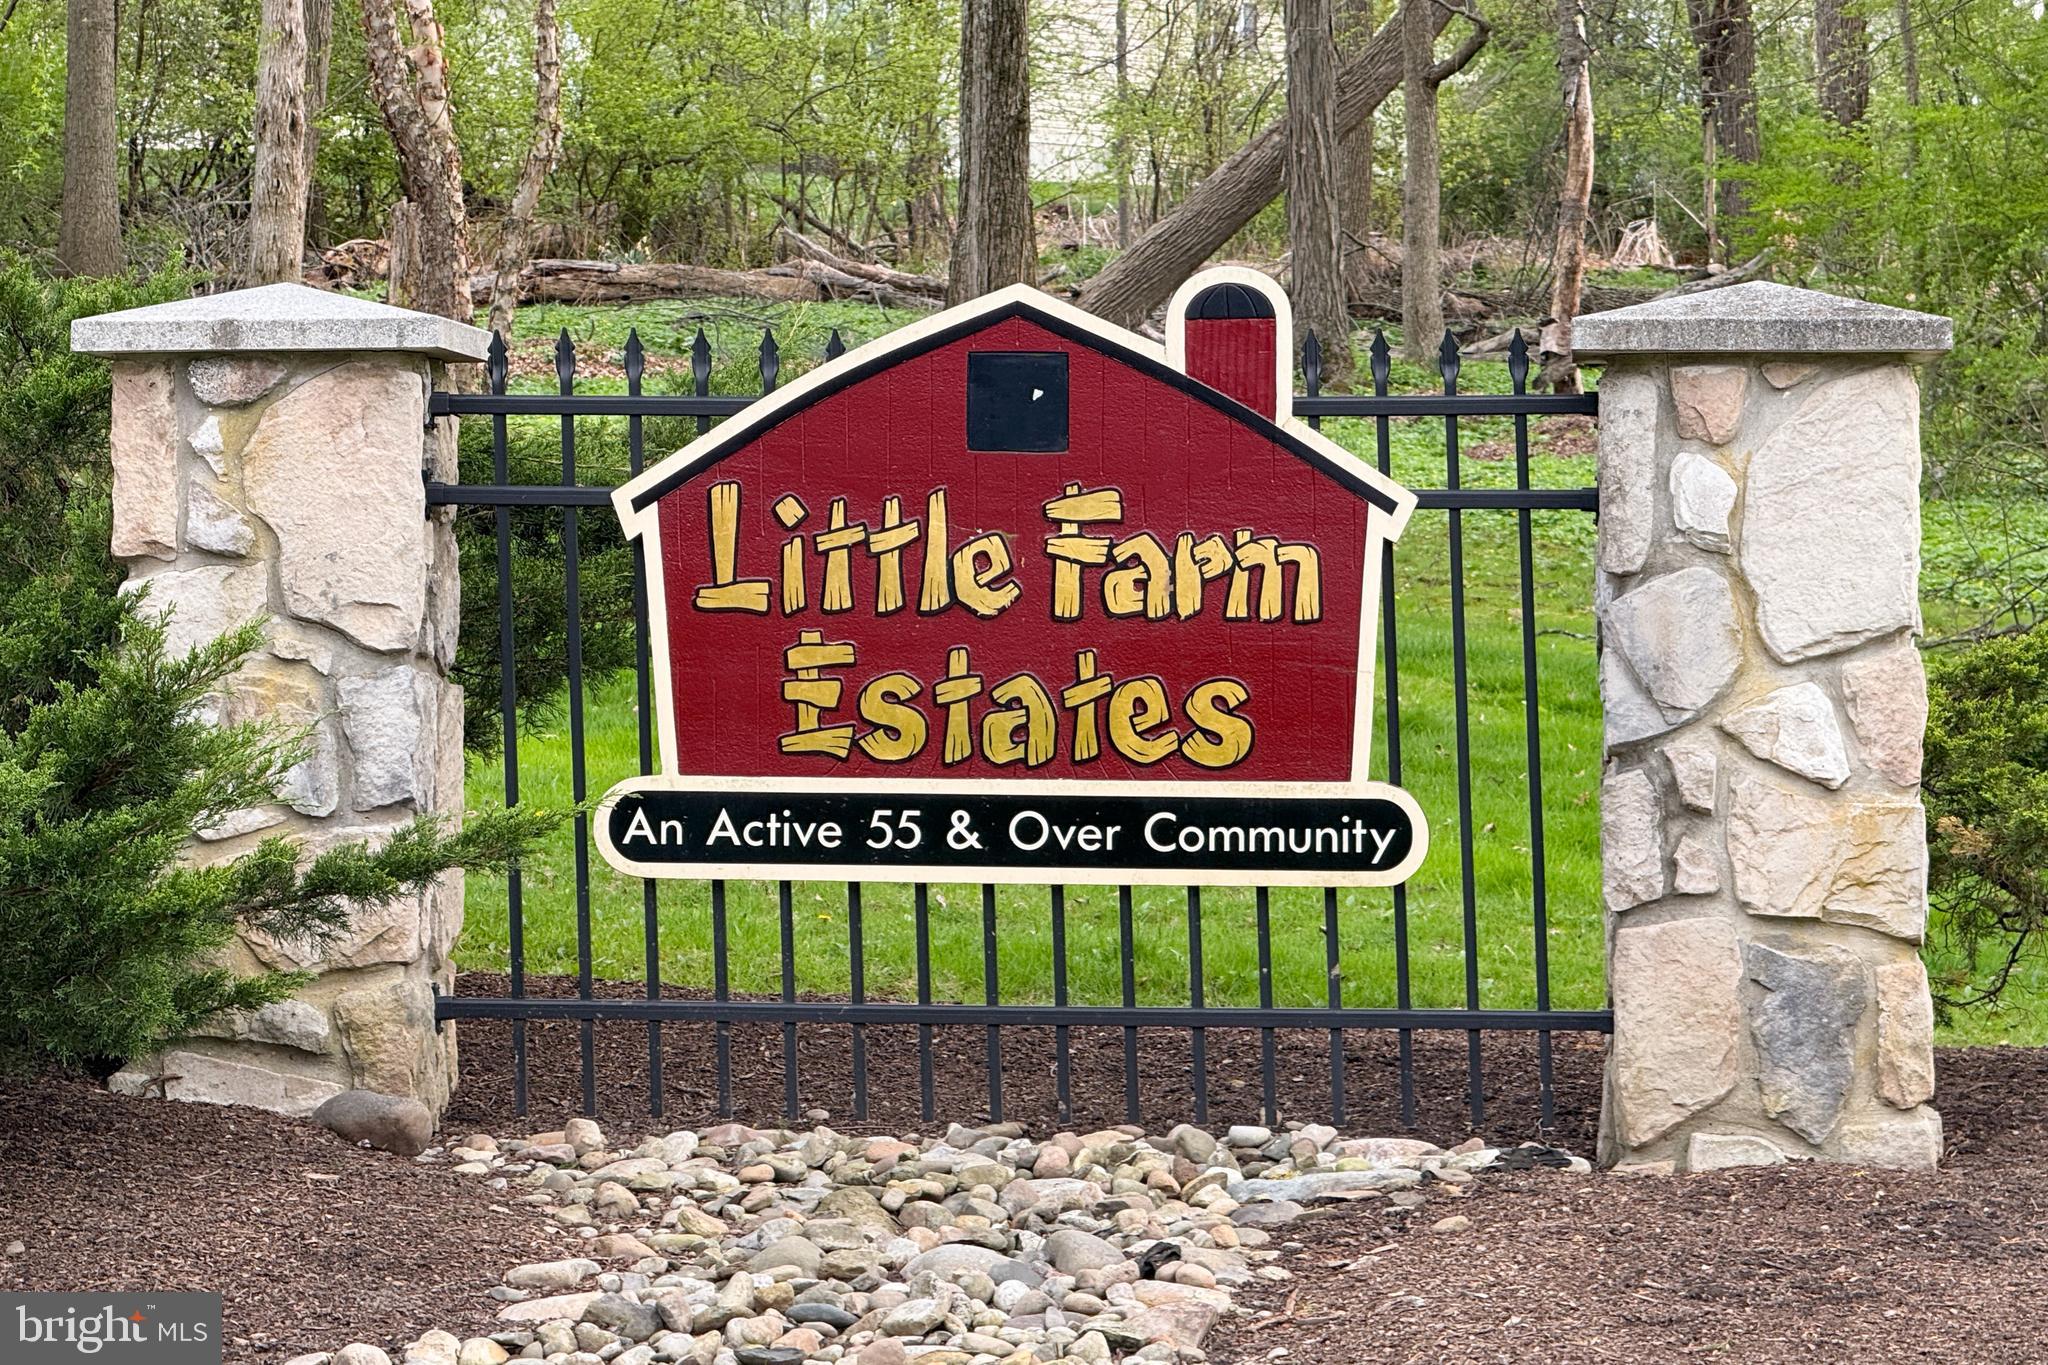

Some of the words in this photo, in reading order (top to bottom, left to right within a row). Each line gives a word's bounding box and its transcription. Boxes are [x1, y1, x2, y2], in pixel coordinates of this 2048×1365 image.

[694, 482, 1020, 616] Little
[1043, 482, 1323, 623] Farm
[779, 629, 1256, 769] Estates
[621, 806, 684, 845] An
[705, 807, 843, 849] Active
[865, 809, 922, 850] 55
[946, 809, 984, 850] &
[1008, 810, 1122, 852] Over
[1144, 811, 1397, 866] Community
